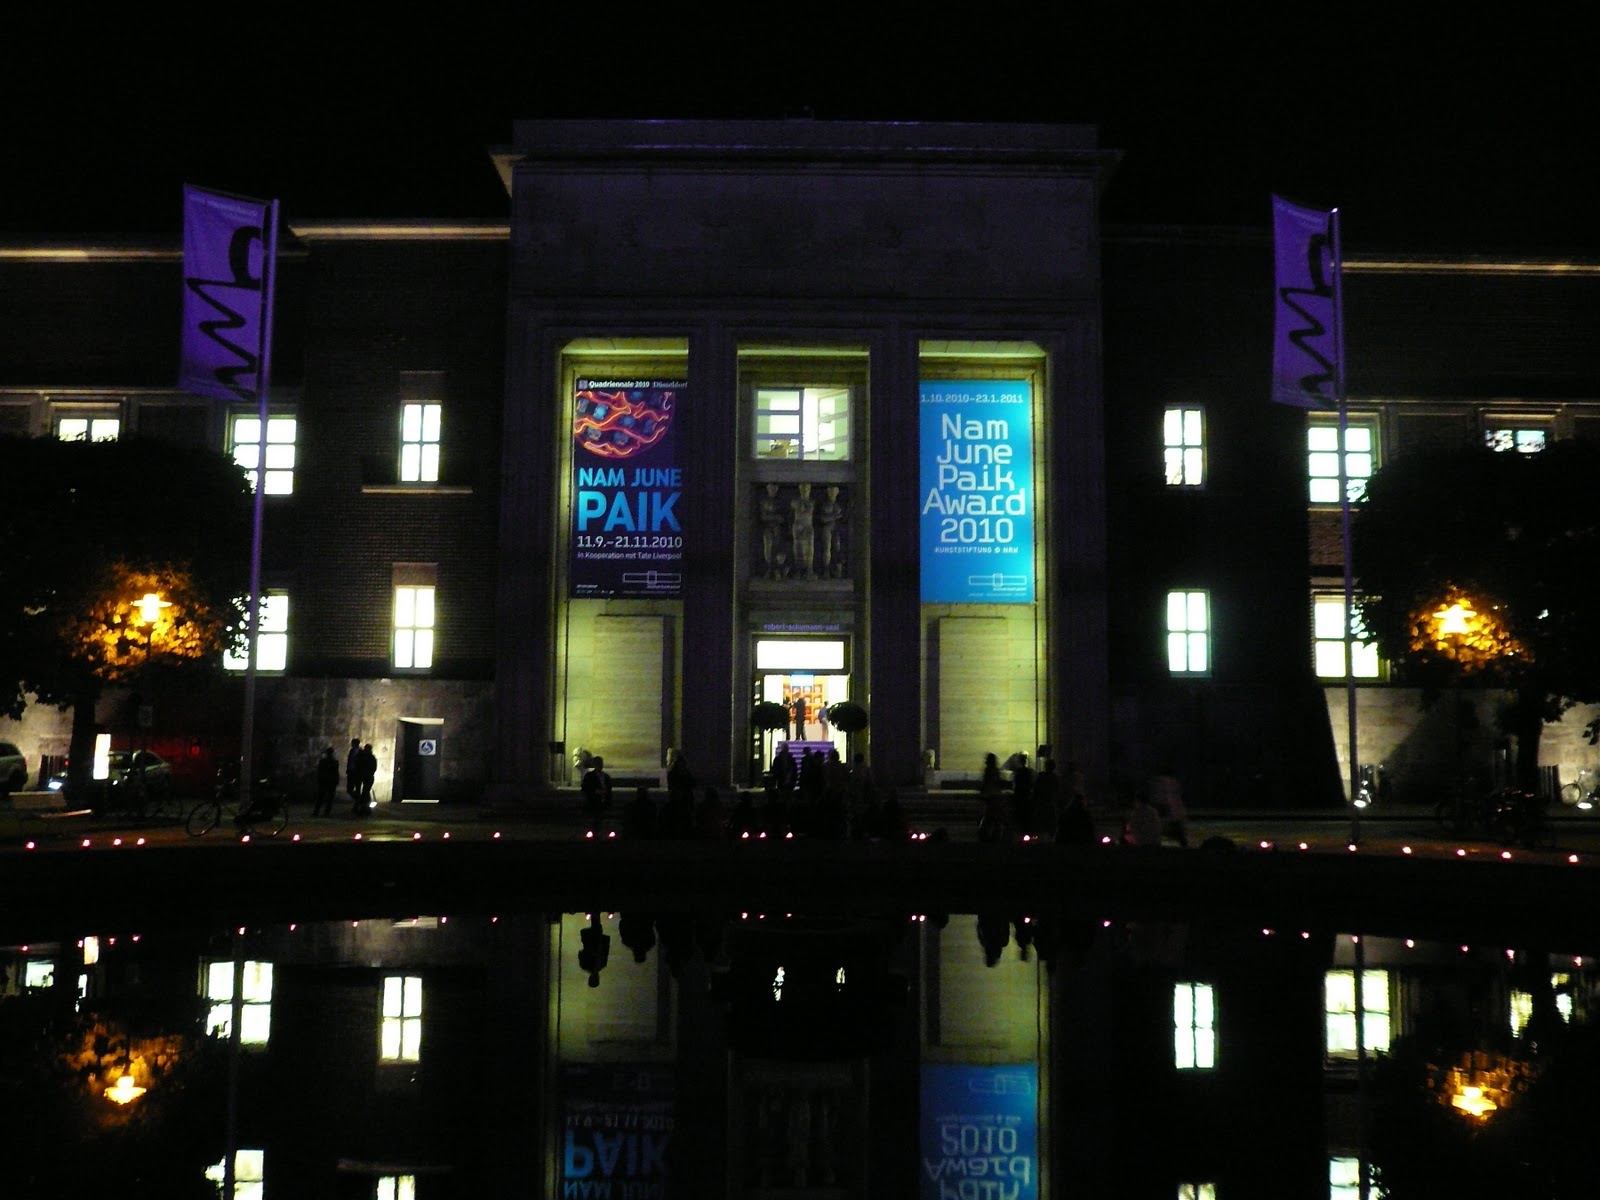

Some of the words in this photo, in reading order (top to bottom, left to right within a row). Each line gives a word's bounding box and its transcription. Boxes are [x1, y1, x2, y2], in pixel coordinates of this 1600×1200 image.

[588, 380, 634, 389] Quadriennale
[635, 380, 650, 389] 2010
[652, 380, 688, 389] Düsseldorf
[941, 413, 1009, 441] Nam
[936, 439, 1013, 465] June
[578, 467, 625, 487] NAM
[630, 467, 683, 488] JUNE
[938, 464, 1016, 492] Paik
[577, 490, 683, 532] PAIK
[922, 487, 1026, 516] Award
[940, 517, 1014, 544] 2010
[585, 551, 624, 560] Kooperation
[625, 551, 636, 559] mit
[638, 551, 652, 559] Tate
[653, 551, 682, 561] Liverpool
[934, 546, 992, 554] KUNSTSTIFTUNG
[1002, 546, 1019, 554] NRW
